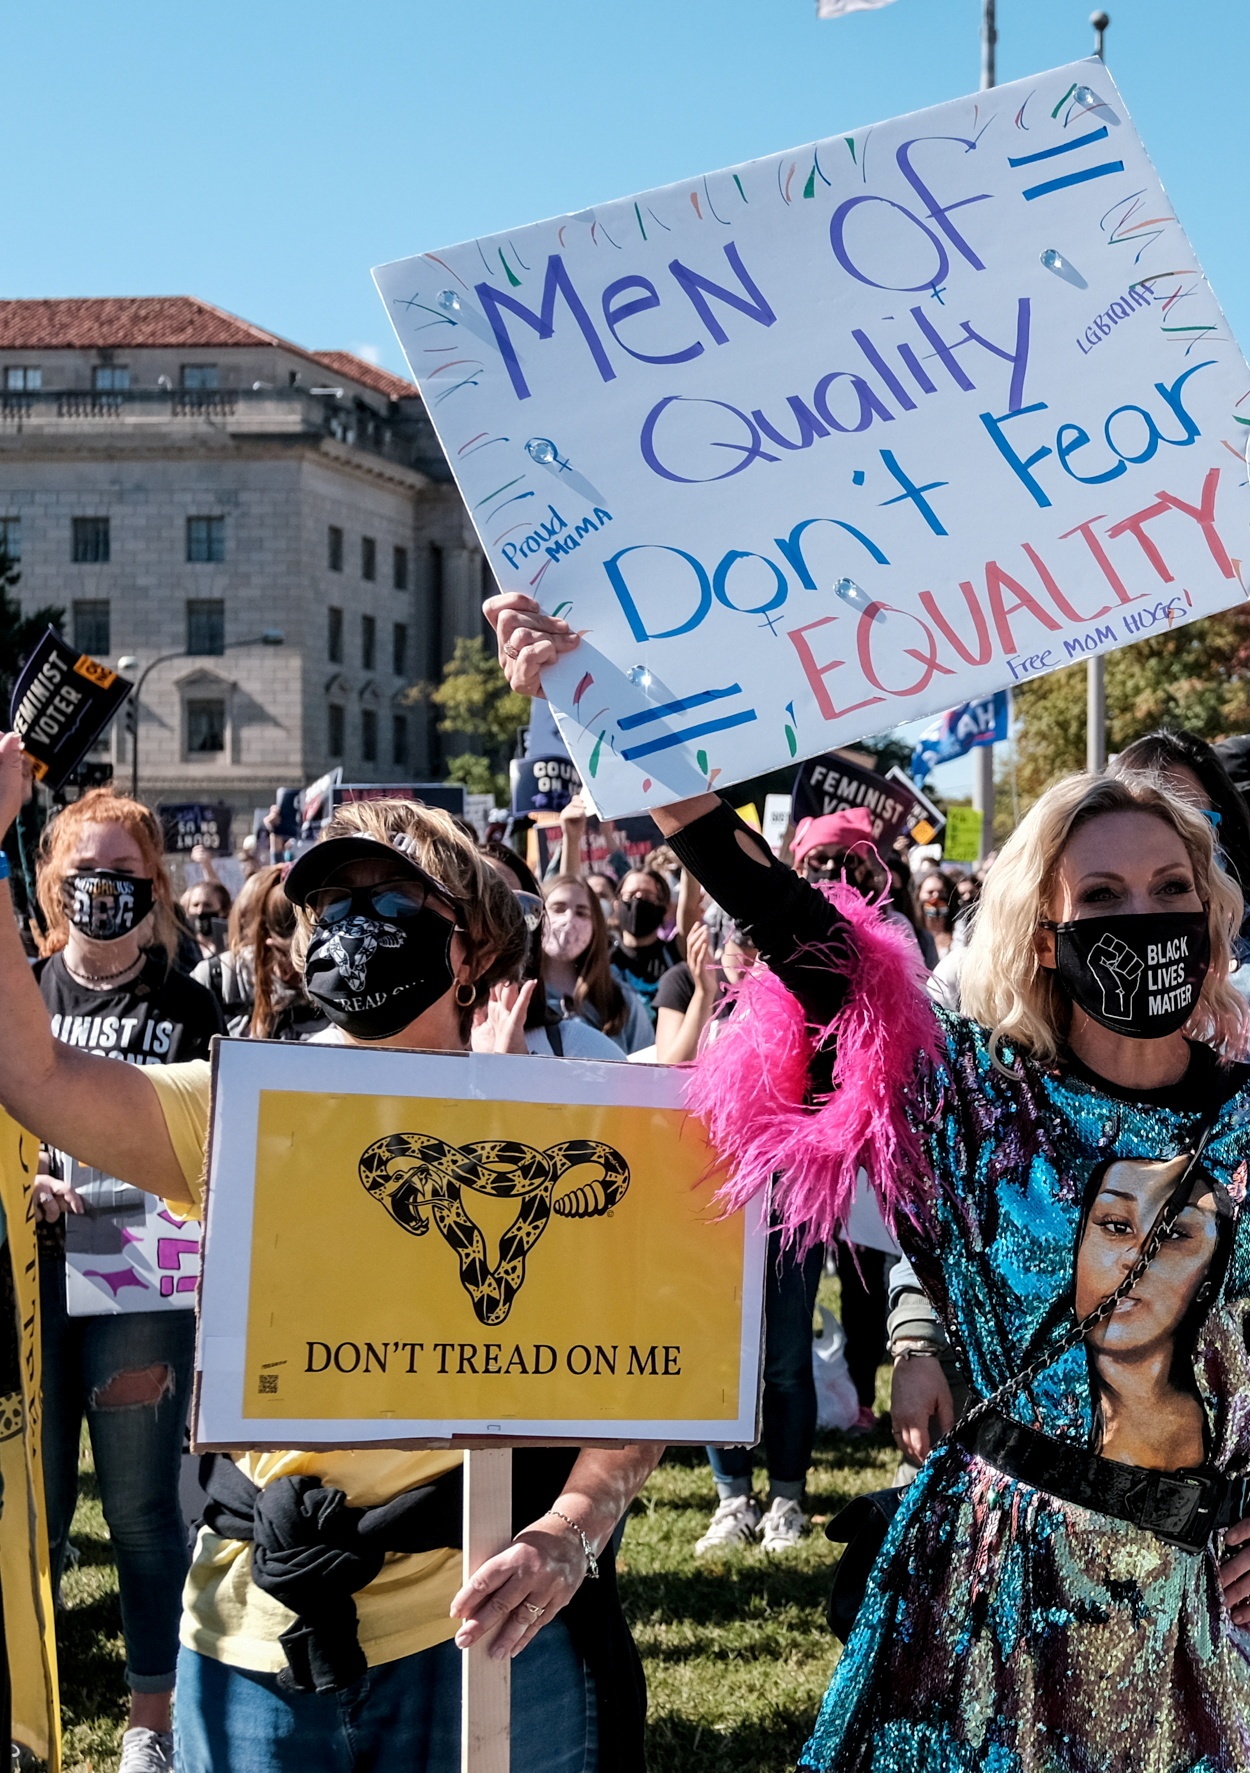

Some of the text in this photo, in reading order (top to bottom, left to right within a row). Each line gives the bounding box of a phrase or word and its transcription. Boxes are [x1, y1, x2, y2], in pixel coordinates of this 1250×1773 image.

[640, 297, 1031, 483] Quality
[602, 360, 1220, 642] Don't Fear
[501, 504, 568, 570] Proud
[787, 468, 1237, 720] EQUALITY
[1006, 649, 1062, 680] Free
[1063, 625, 1118, 658] MOM
[30, 685, 83, 745] VOTER
[538, 777, 563, 793] ON
[809, 765, 905, 824] FEMINIST
[1147, 935, 1189, 966] BLACK
[1148, 962, 1185, 991] LIVES
[1149, 983, 1193, 1016] MATTER
[142, 1018, 174, 1053] IS
[304, 1340, 683, 1377] DON'T TREAD ON ME
